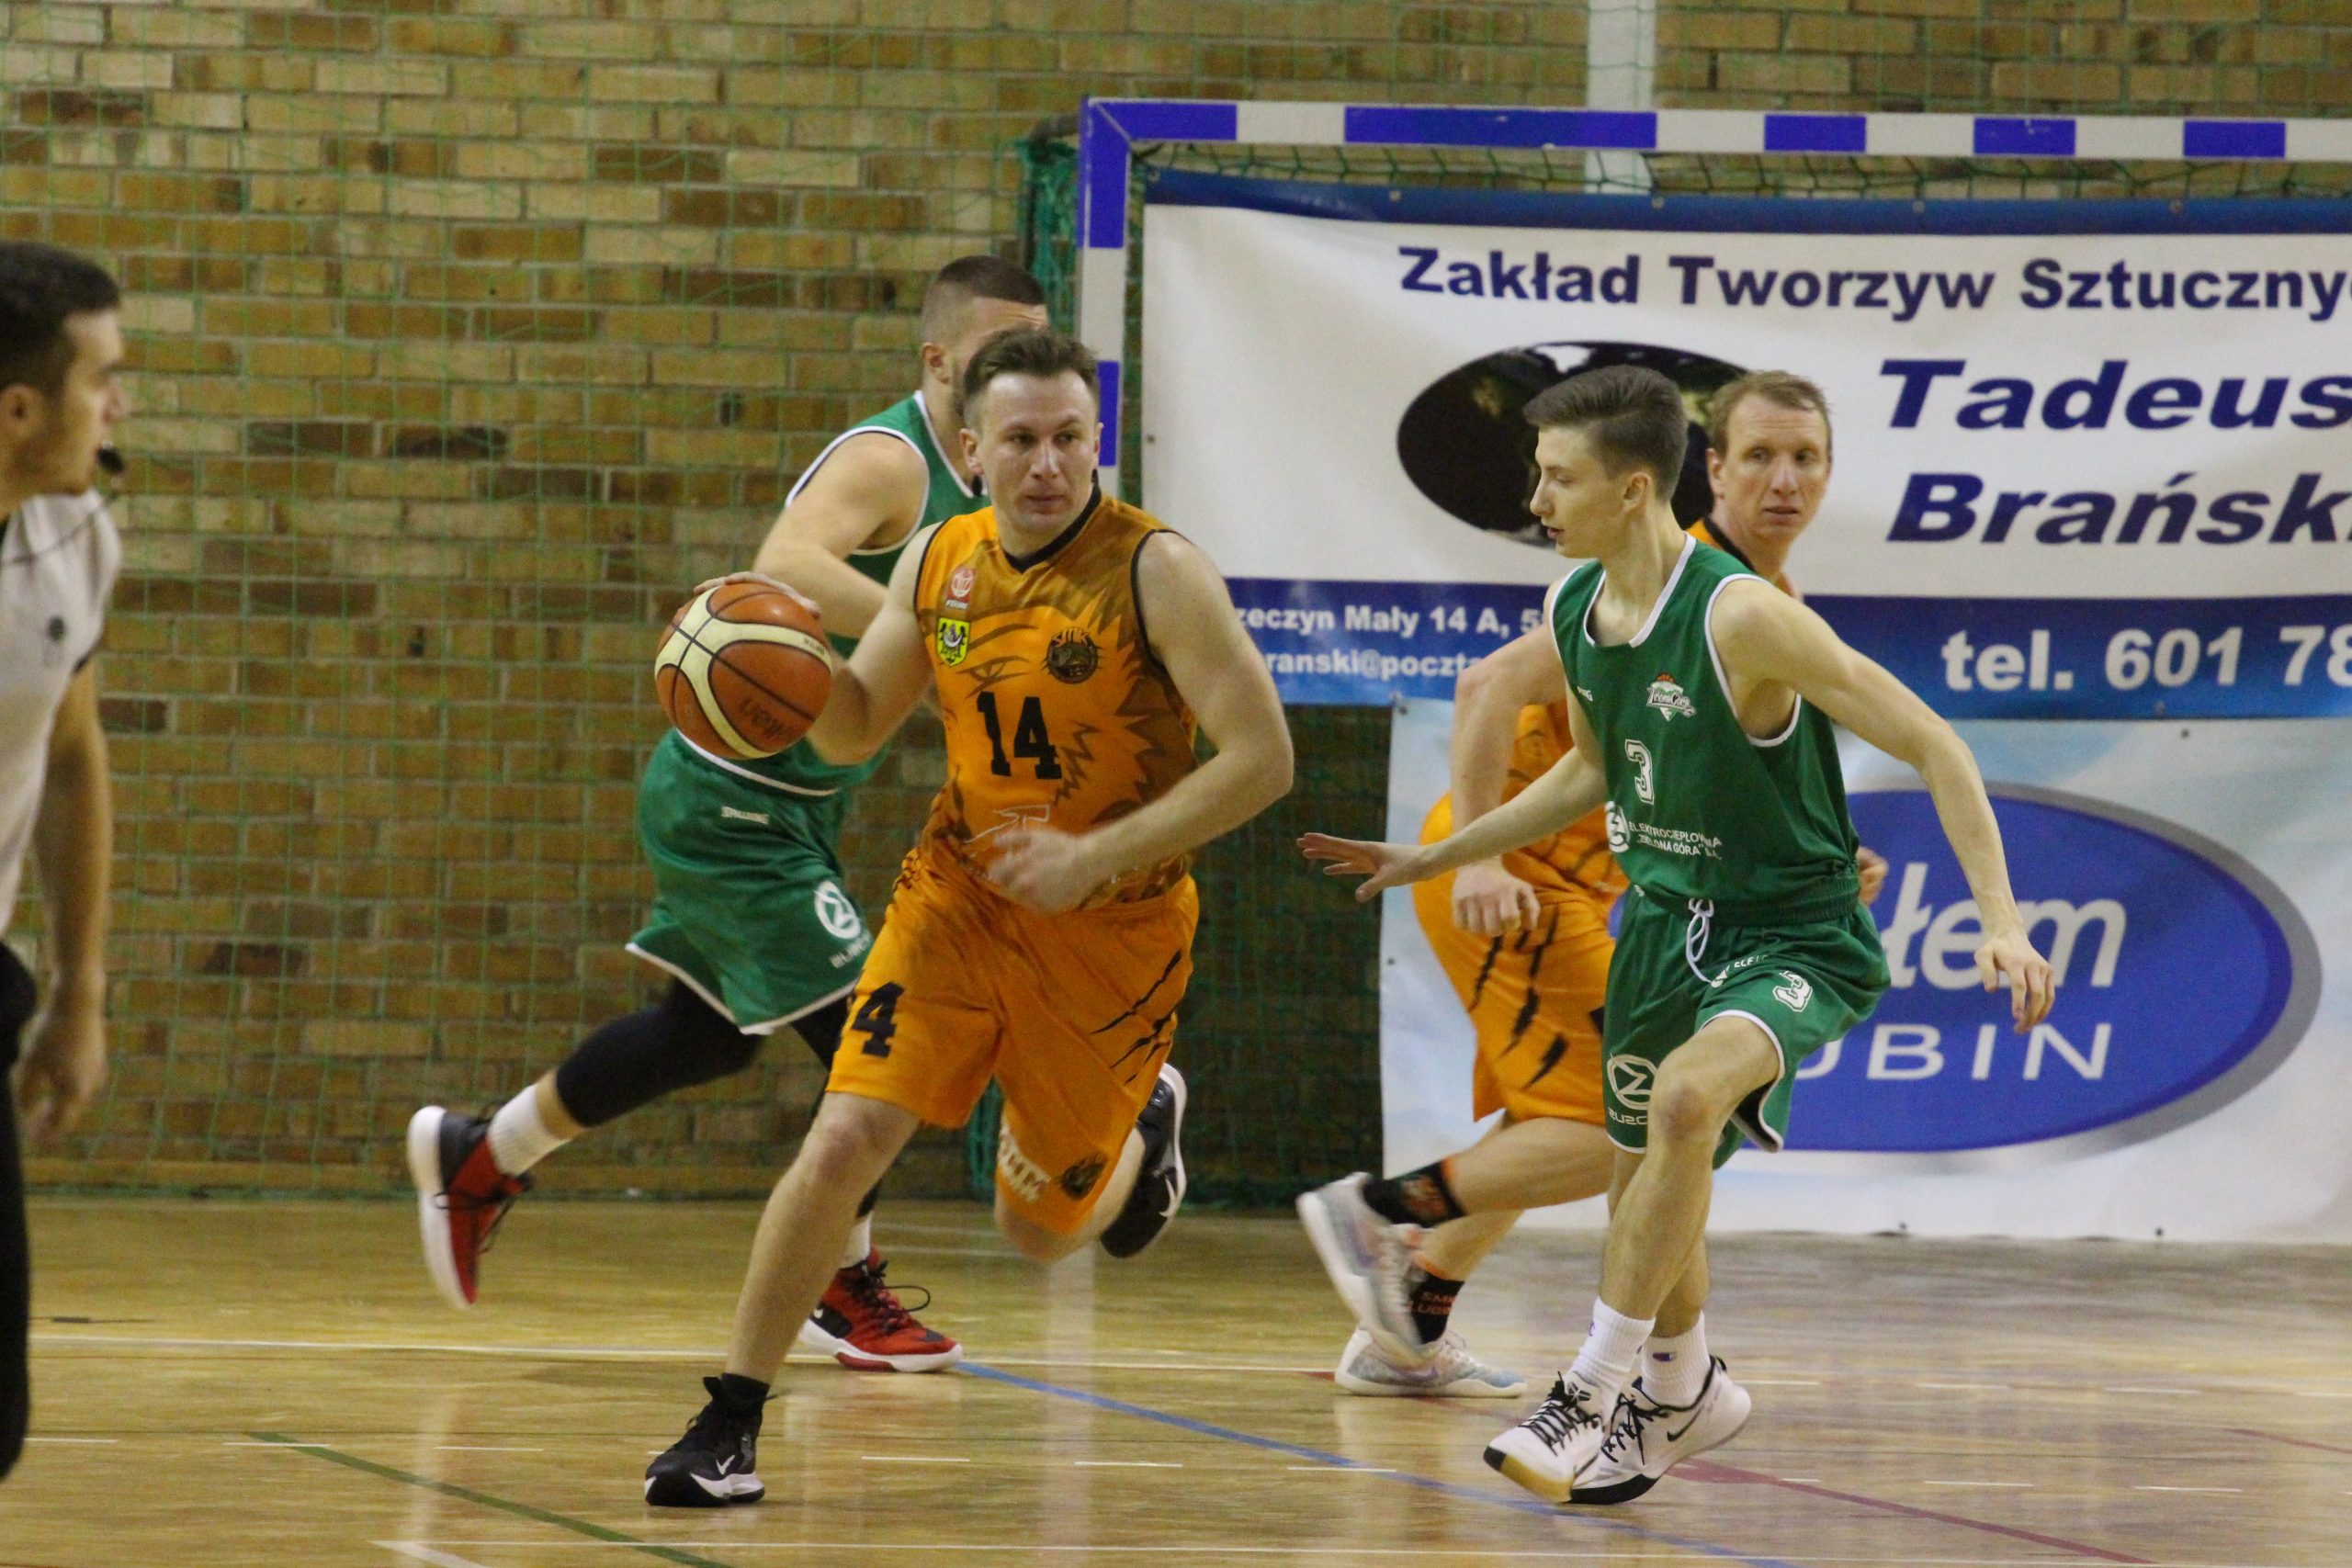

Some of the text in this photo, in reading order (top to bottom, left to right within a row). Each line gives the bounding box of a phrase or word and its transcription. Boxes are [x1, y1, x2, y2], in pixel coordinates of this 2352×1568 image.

[1397, 244, 2352, 322] Zakład Tworzyw Sztuczny
[1884, 471, 2352, 546] Brańsk
[1236, 604, 1544, 639] zeczyn Mały 14 A, 5
[1265, 649, 1483, 681] ranski@poczt
[1941, 629, 2075, 691] tel.
[2105, 626, 2242, 692] 601
[976, 691, 1062, 780] 14
[1624, 739, 1655, 806] 3
[1881, 862, 2128, 990] łem
[850, 981, 905, 1058] 4
[1772, 970, 1813, 1012] 3
